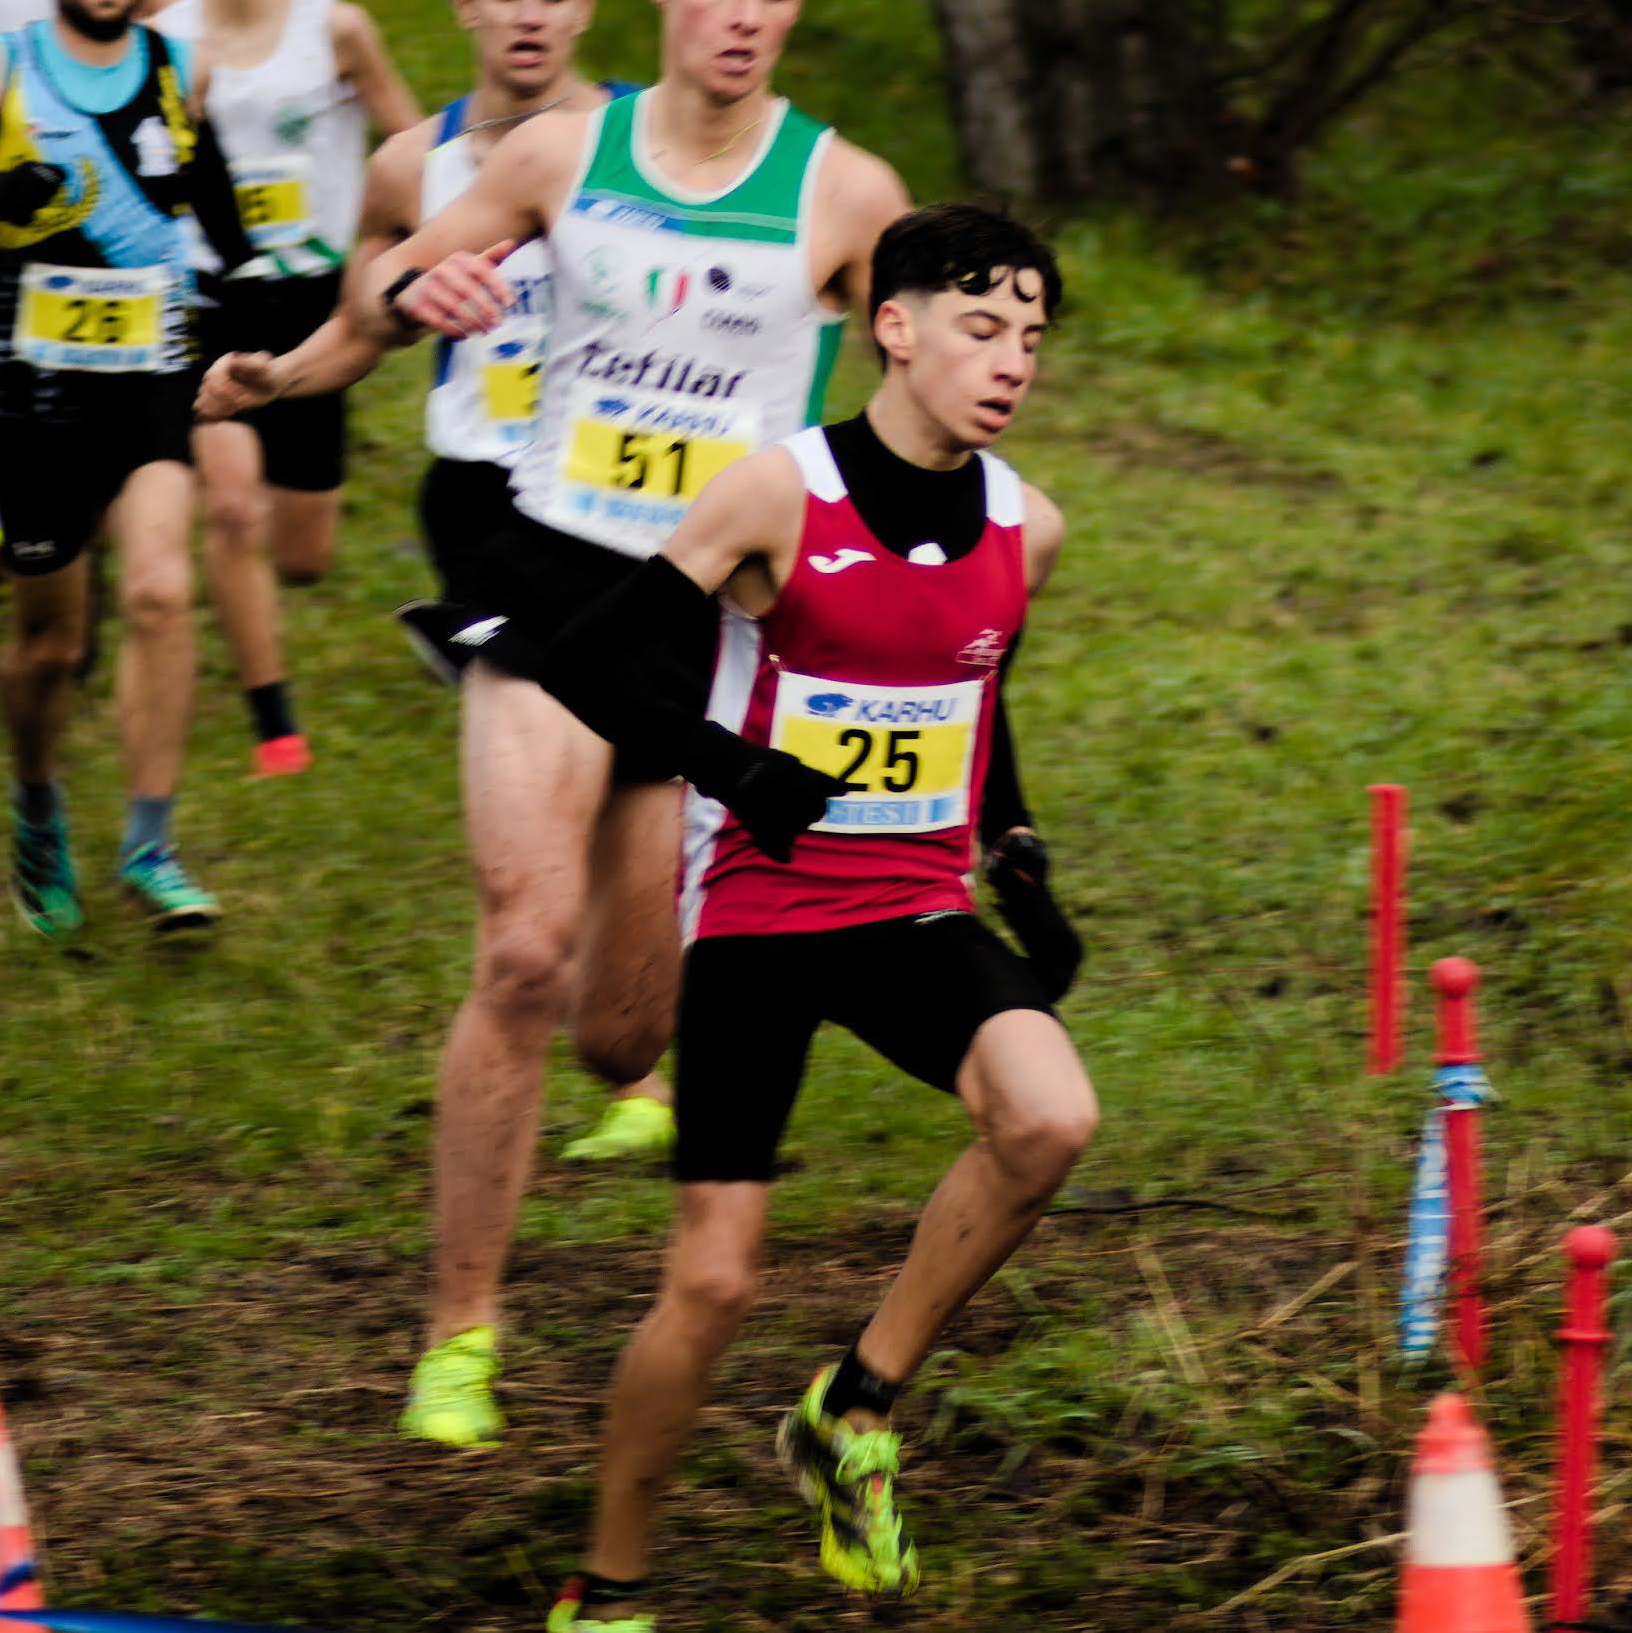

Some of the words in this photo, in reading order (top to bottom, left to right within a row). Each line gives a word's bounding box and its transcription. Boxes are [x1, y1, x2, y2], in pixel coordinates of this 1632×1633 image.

[62, 298, 129, 344] 26
[611, 432, 690, 497] 51
[855, 696, 959, 723] KARHU
[835, 728, 923, 793] 25
